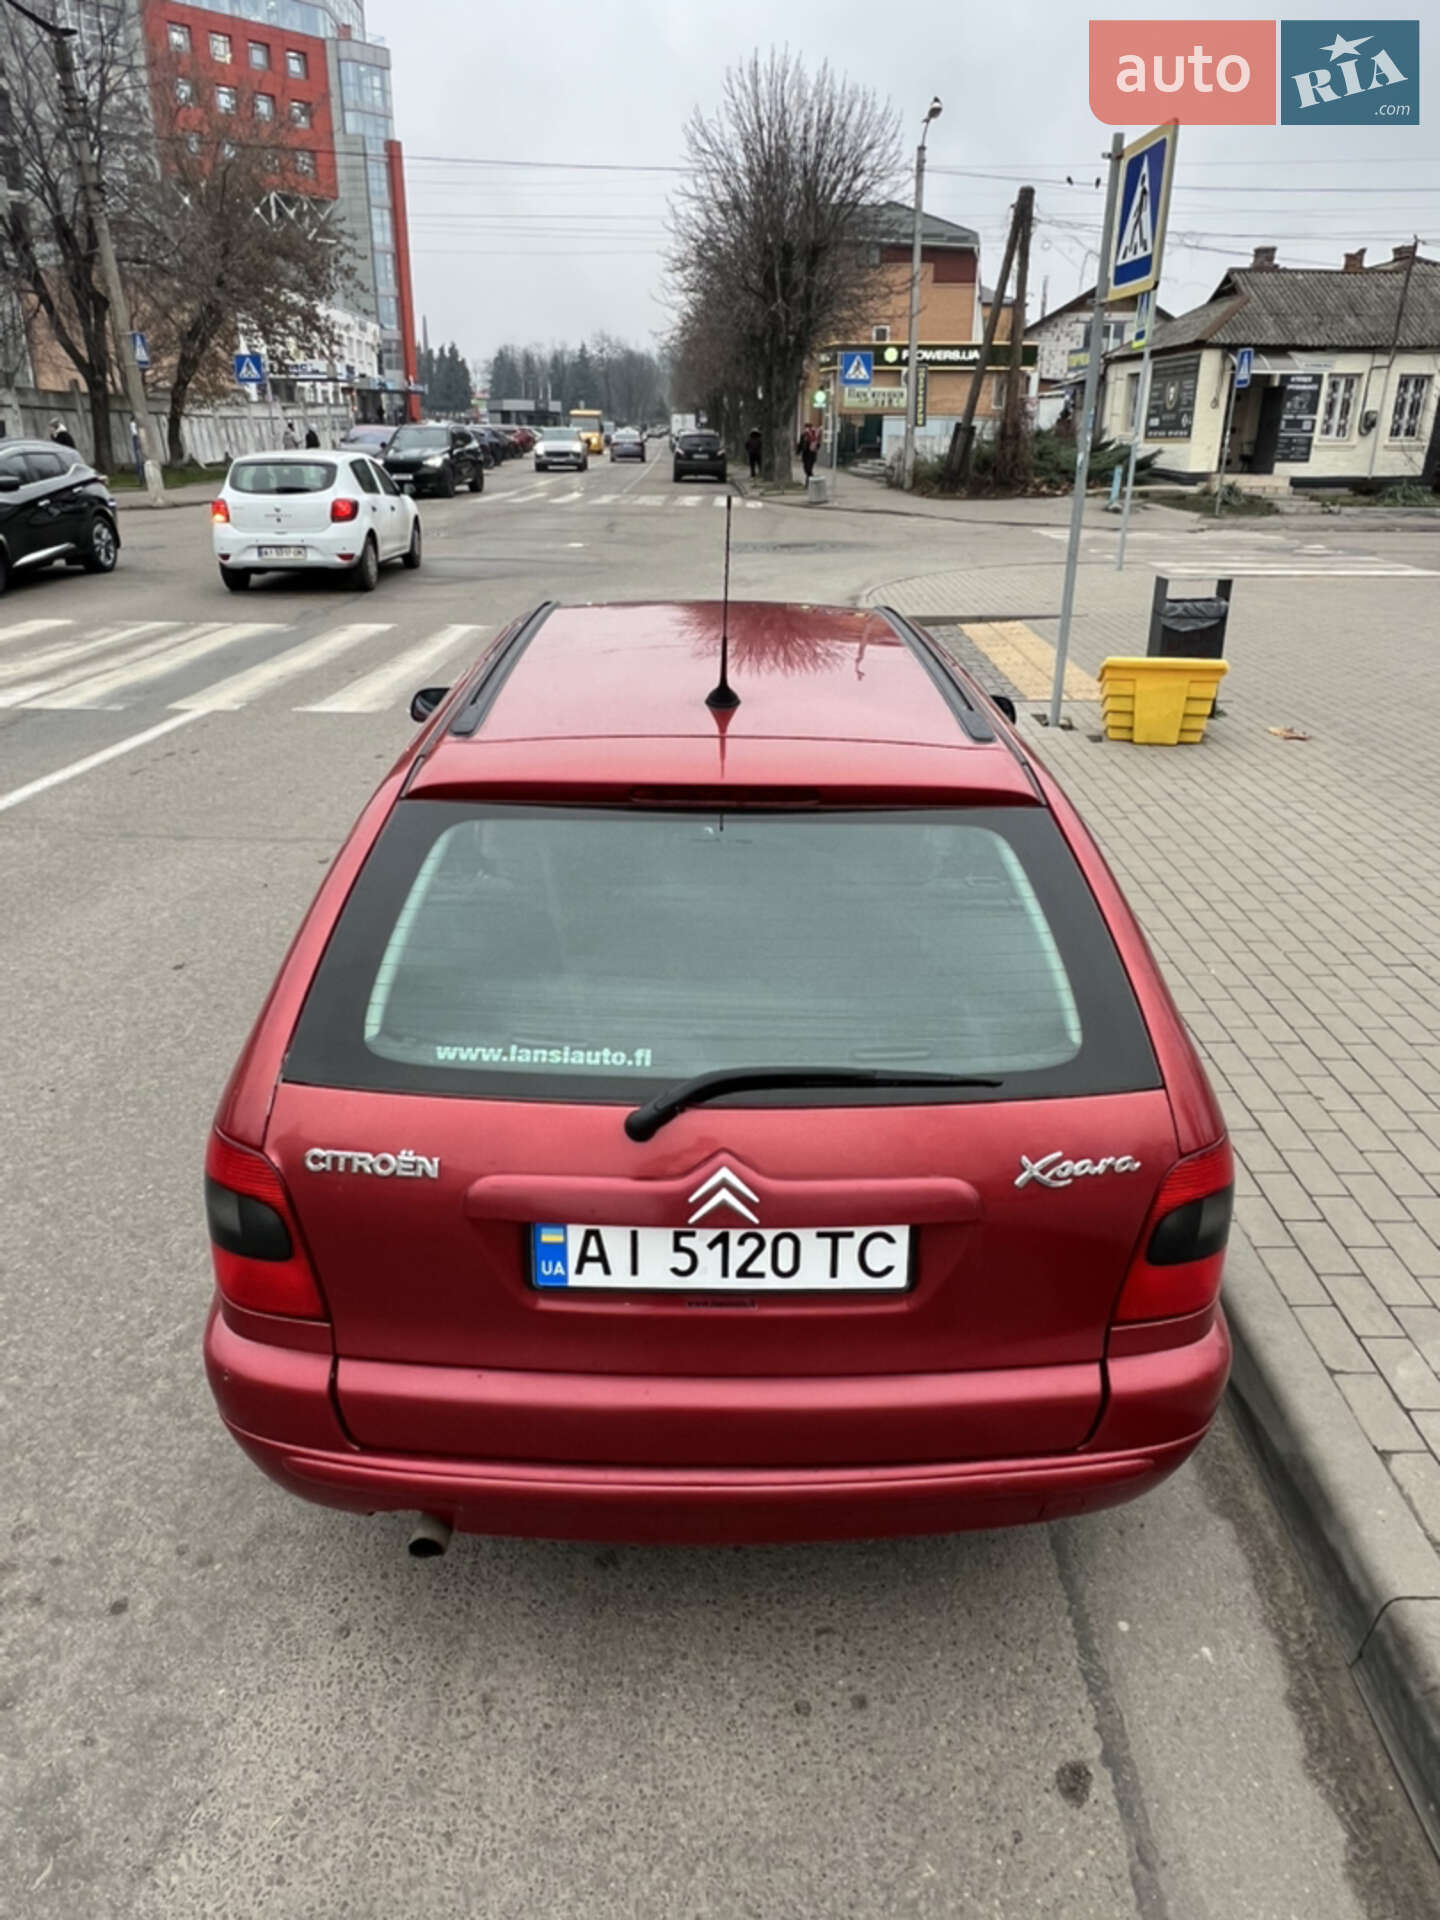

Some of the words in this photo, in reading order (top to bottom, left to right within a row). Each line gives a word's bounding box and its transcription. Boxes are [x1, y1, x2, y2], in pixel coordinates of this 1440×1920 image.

[901, 348, 981, 361] FOWERS.UA
[304, 1147, 441, 1180] CITROËN
[669, 1230, 801, 1280] 5120
[816, 1230, 897, 1279] TC
[541, 1261, 566, 1277] UA
